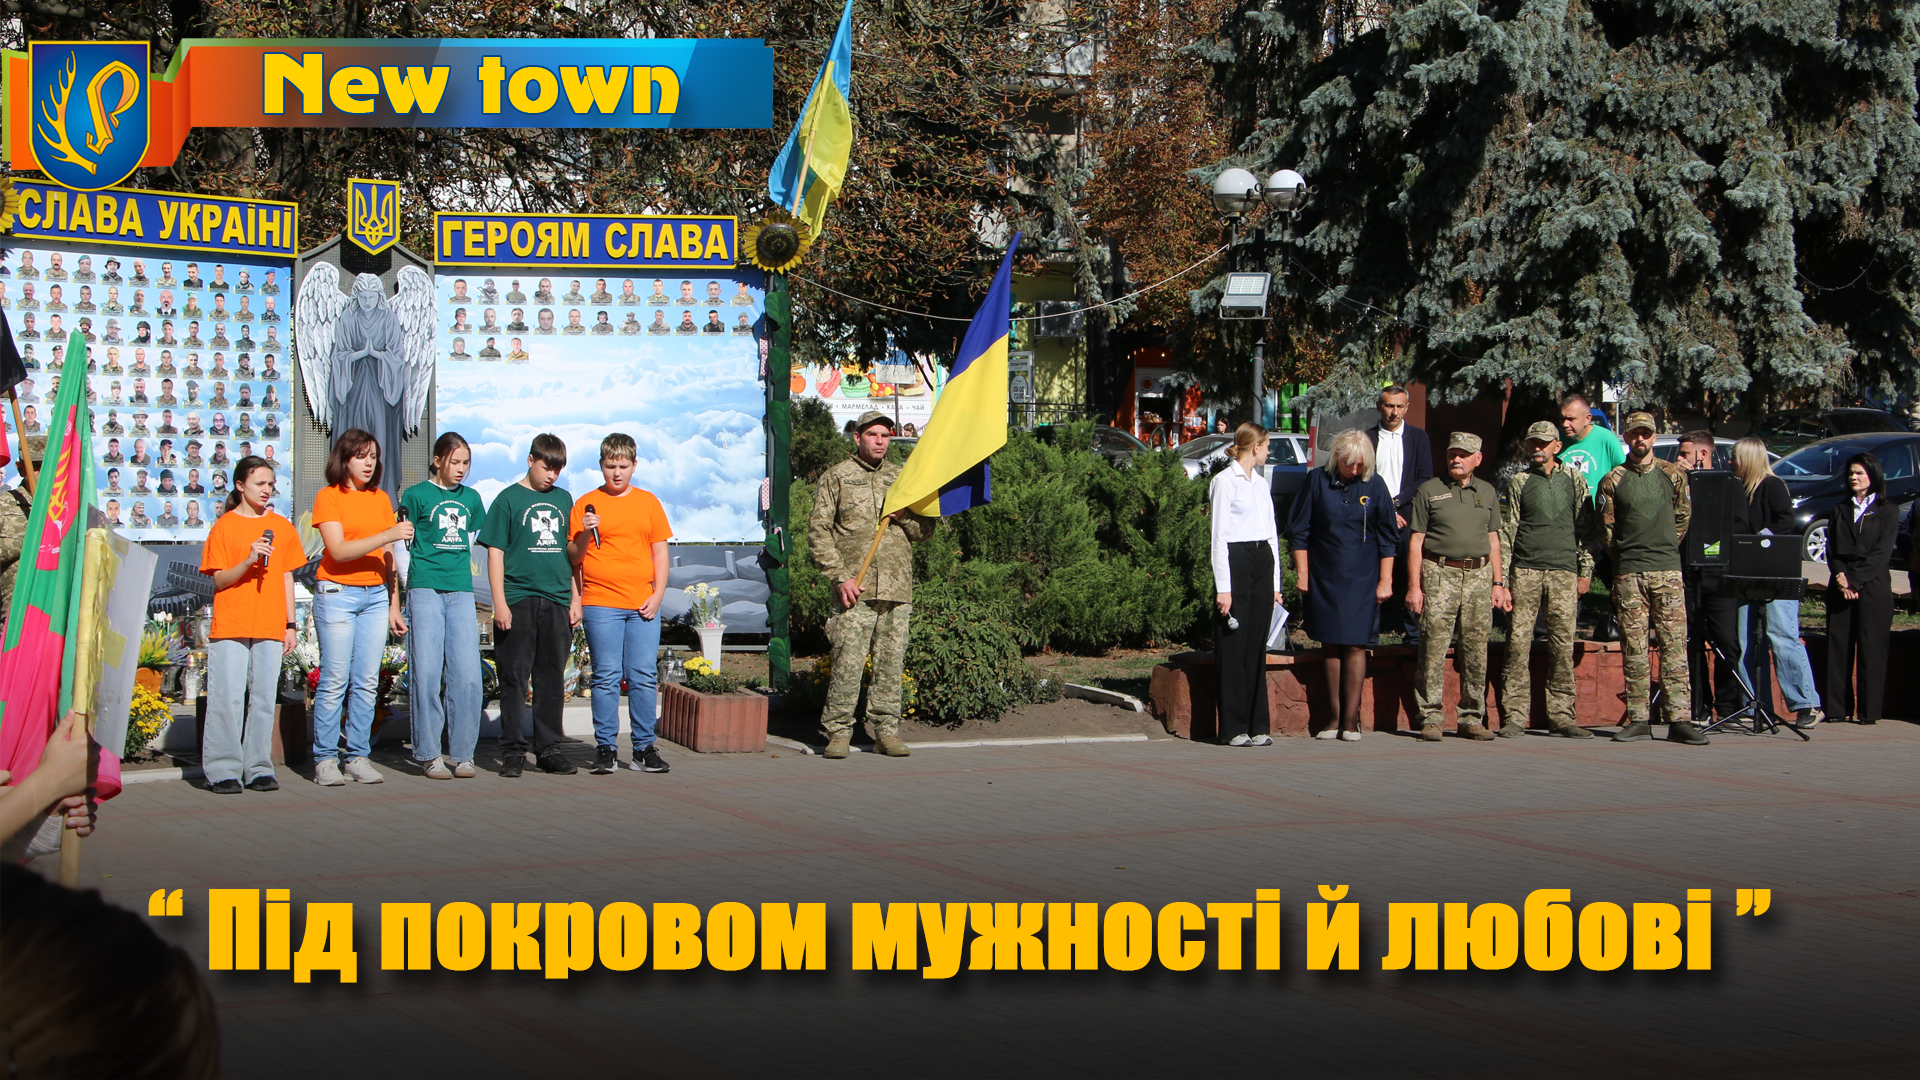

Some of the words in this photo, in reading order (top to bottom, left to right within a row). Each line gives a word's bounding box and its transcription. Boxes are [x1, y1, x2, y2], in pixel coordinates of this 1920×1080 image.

[18, 187, 145, 238] СЛАВА
[158, 200, 294, 249] УКРАЇНІ
[442, 220, 590, 259] ГЕРОЯМ
[605, 222, 730, 261] СЛАВА
[841, 403, 879, 411] МАРМЕЛАД
[886, 403, 904, 411] КАА
[911, 403, 925, 411] ЧАЙ
